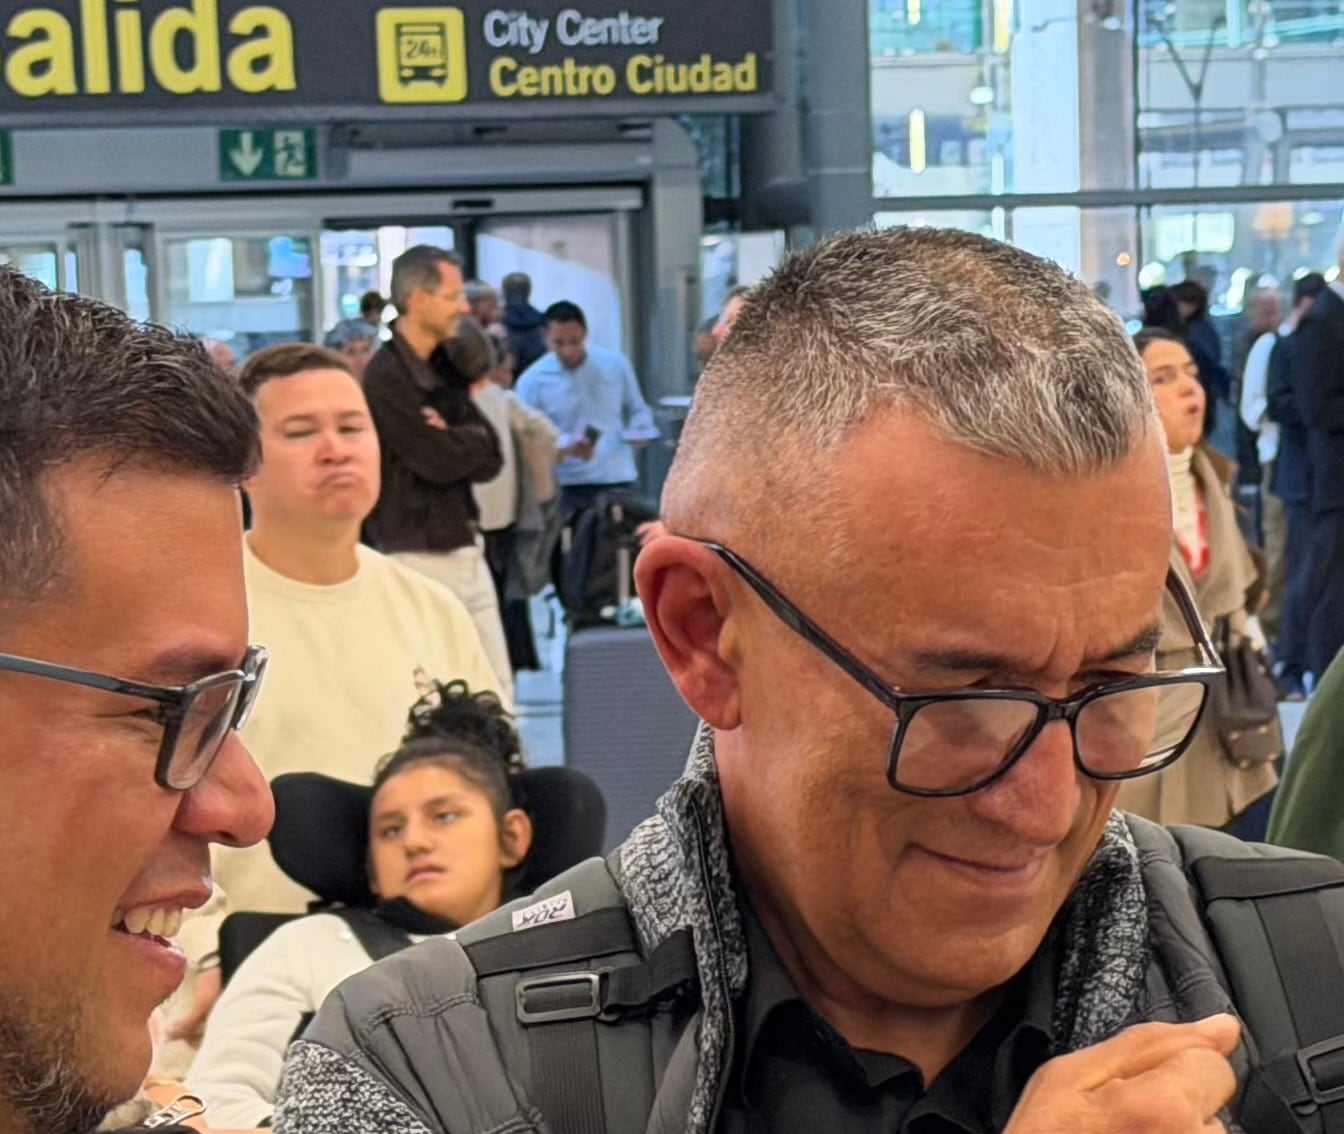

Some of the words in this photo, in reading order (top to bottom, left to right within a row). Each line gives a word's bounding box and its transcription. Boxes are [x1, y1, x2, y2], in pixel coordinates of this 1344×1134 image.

[483, 9, 549, 54] City
[556, 8, 664, 47] Center
[489, 55, 616, 97] Centro
[626, 52, 757, 93] Ciudad
